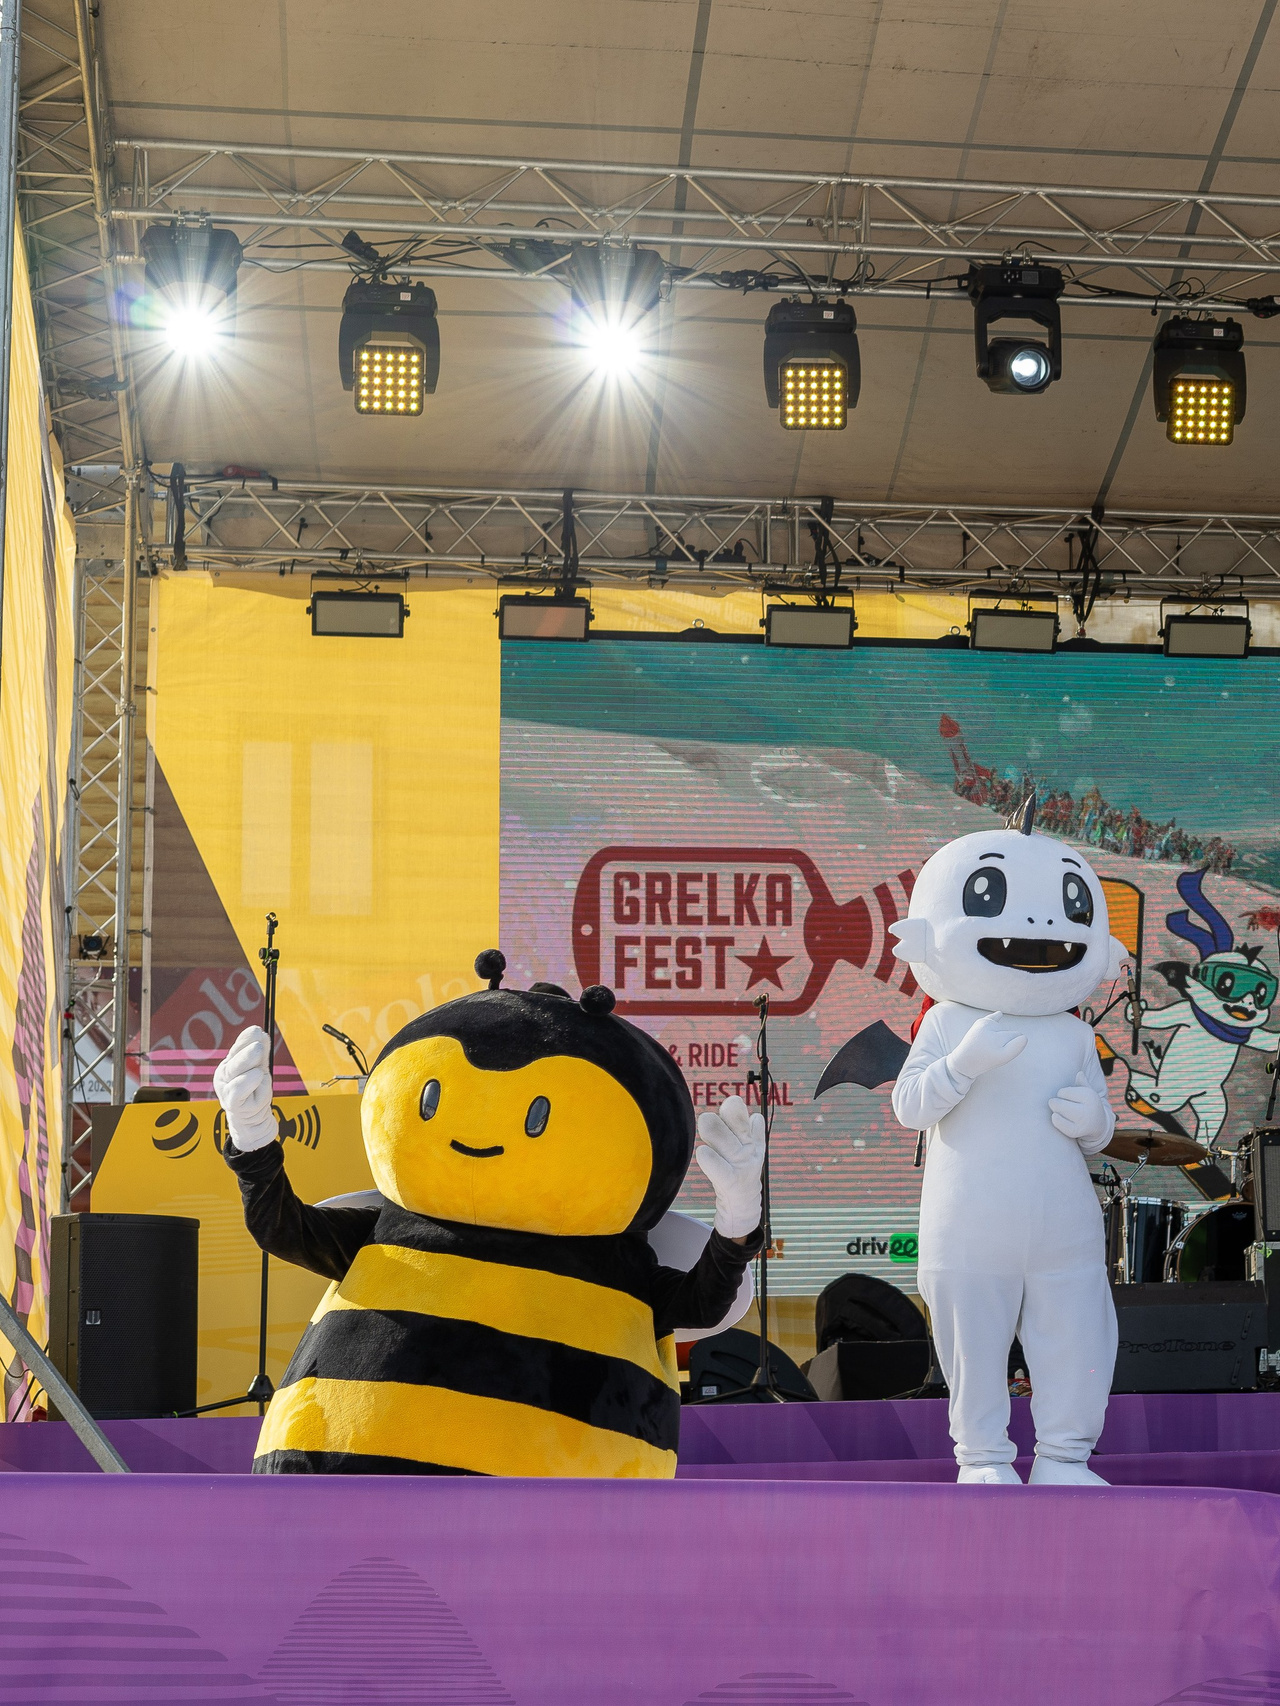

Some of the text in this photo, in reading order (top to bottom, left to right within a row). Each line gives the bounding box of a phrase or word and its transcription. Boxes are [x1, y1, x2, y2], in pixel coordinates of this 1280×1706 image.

[613, 872, 792, 927] GRELKA
[613, 935, 735, 990] FEST
[688, 1043, 739, 1068] RIDE
[846, 1236, 919, 1258] drivee
